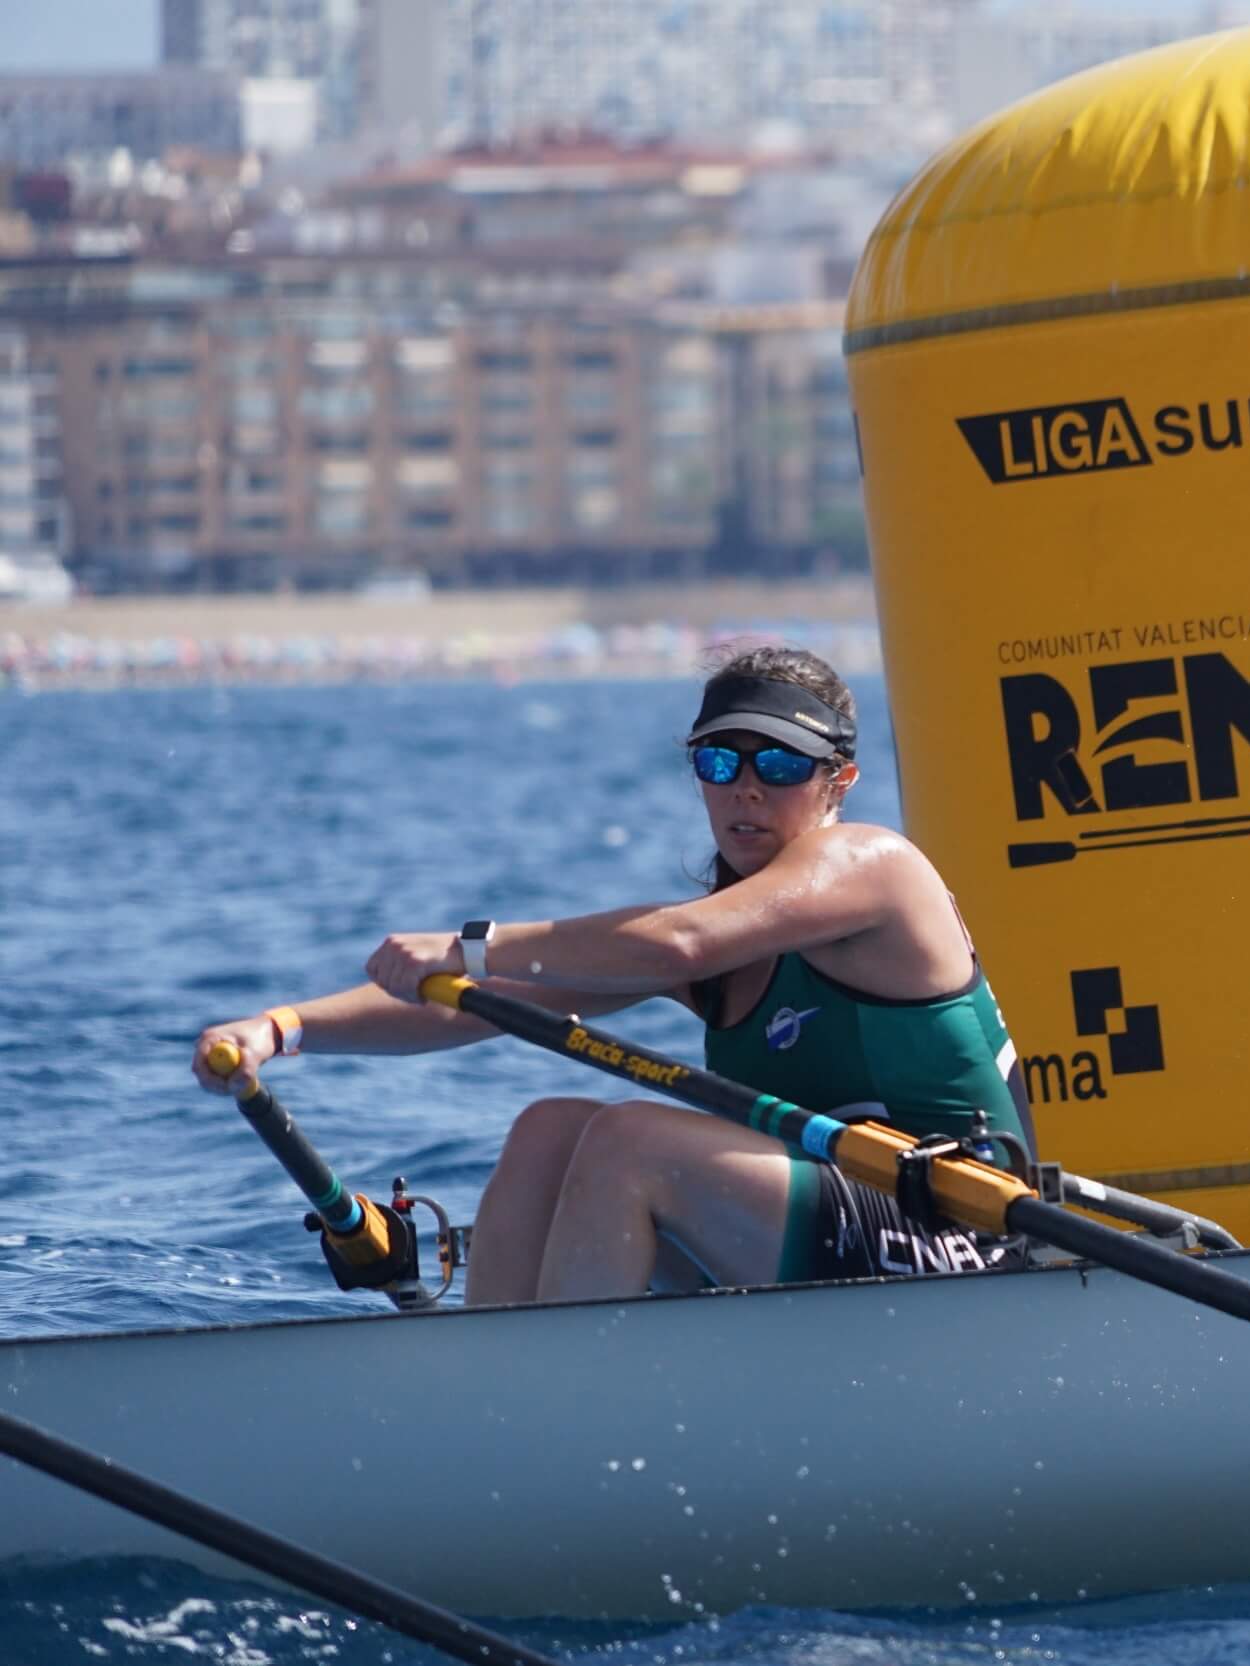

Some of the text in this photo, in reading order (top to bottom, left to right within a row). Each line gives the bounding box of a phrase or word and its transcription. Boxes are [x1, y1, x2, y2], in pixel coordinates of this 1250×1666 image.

[998, 404, 1143, 479] LIGA
[996, 626, 1124, 665] COMUNITAT
[1022, 1050, 1108, 1106] ma
